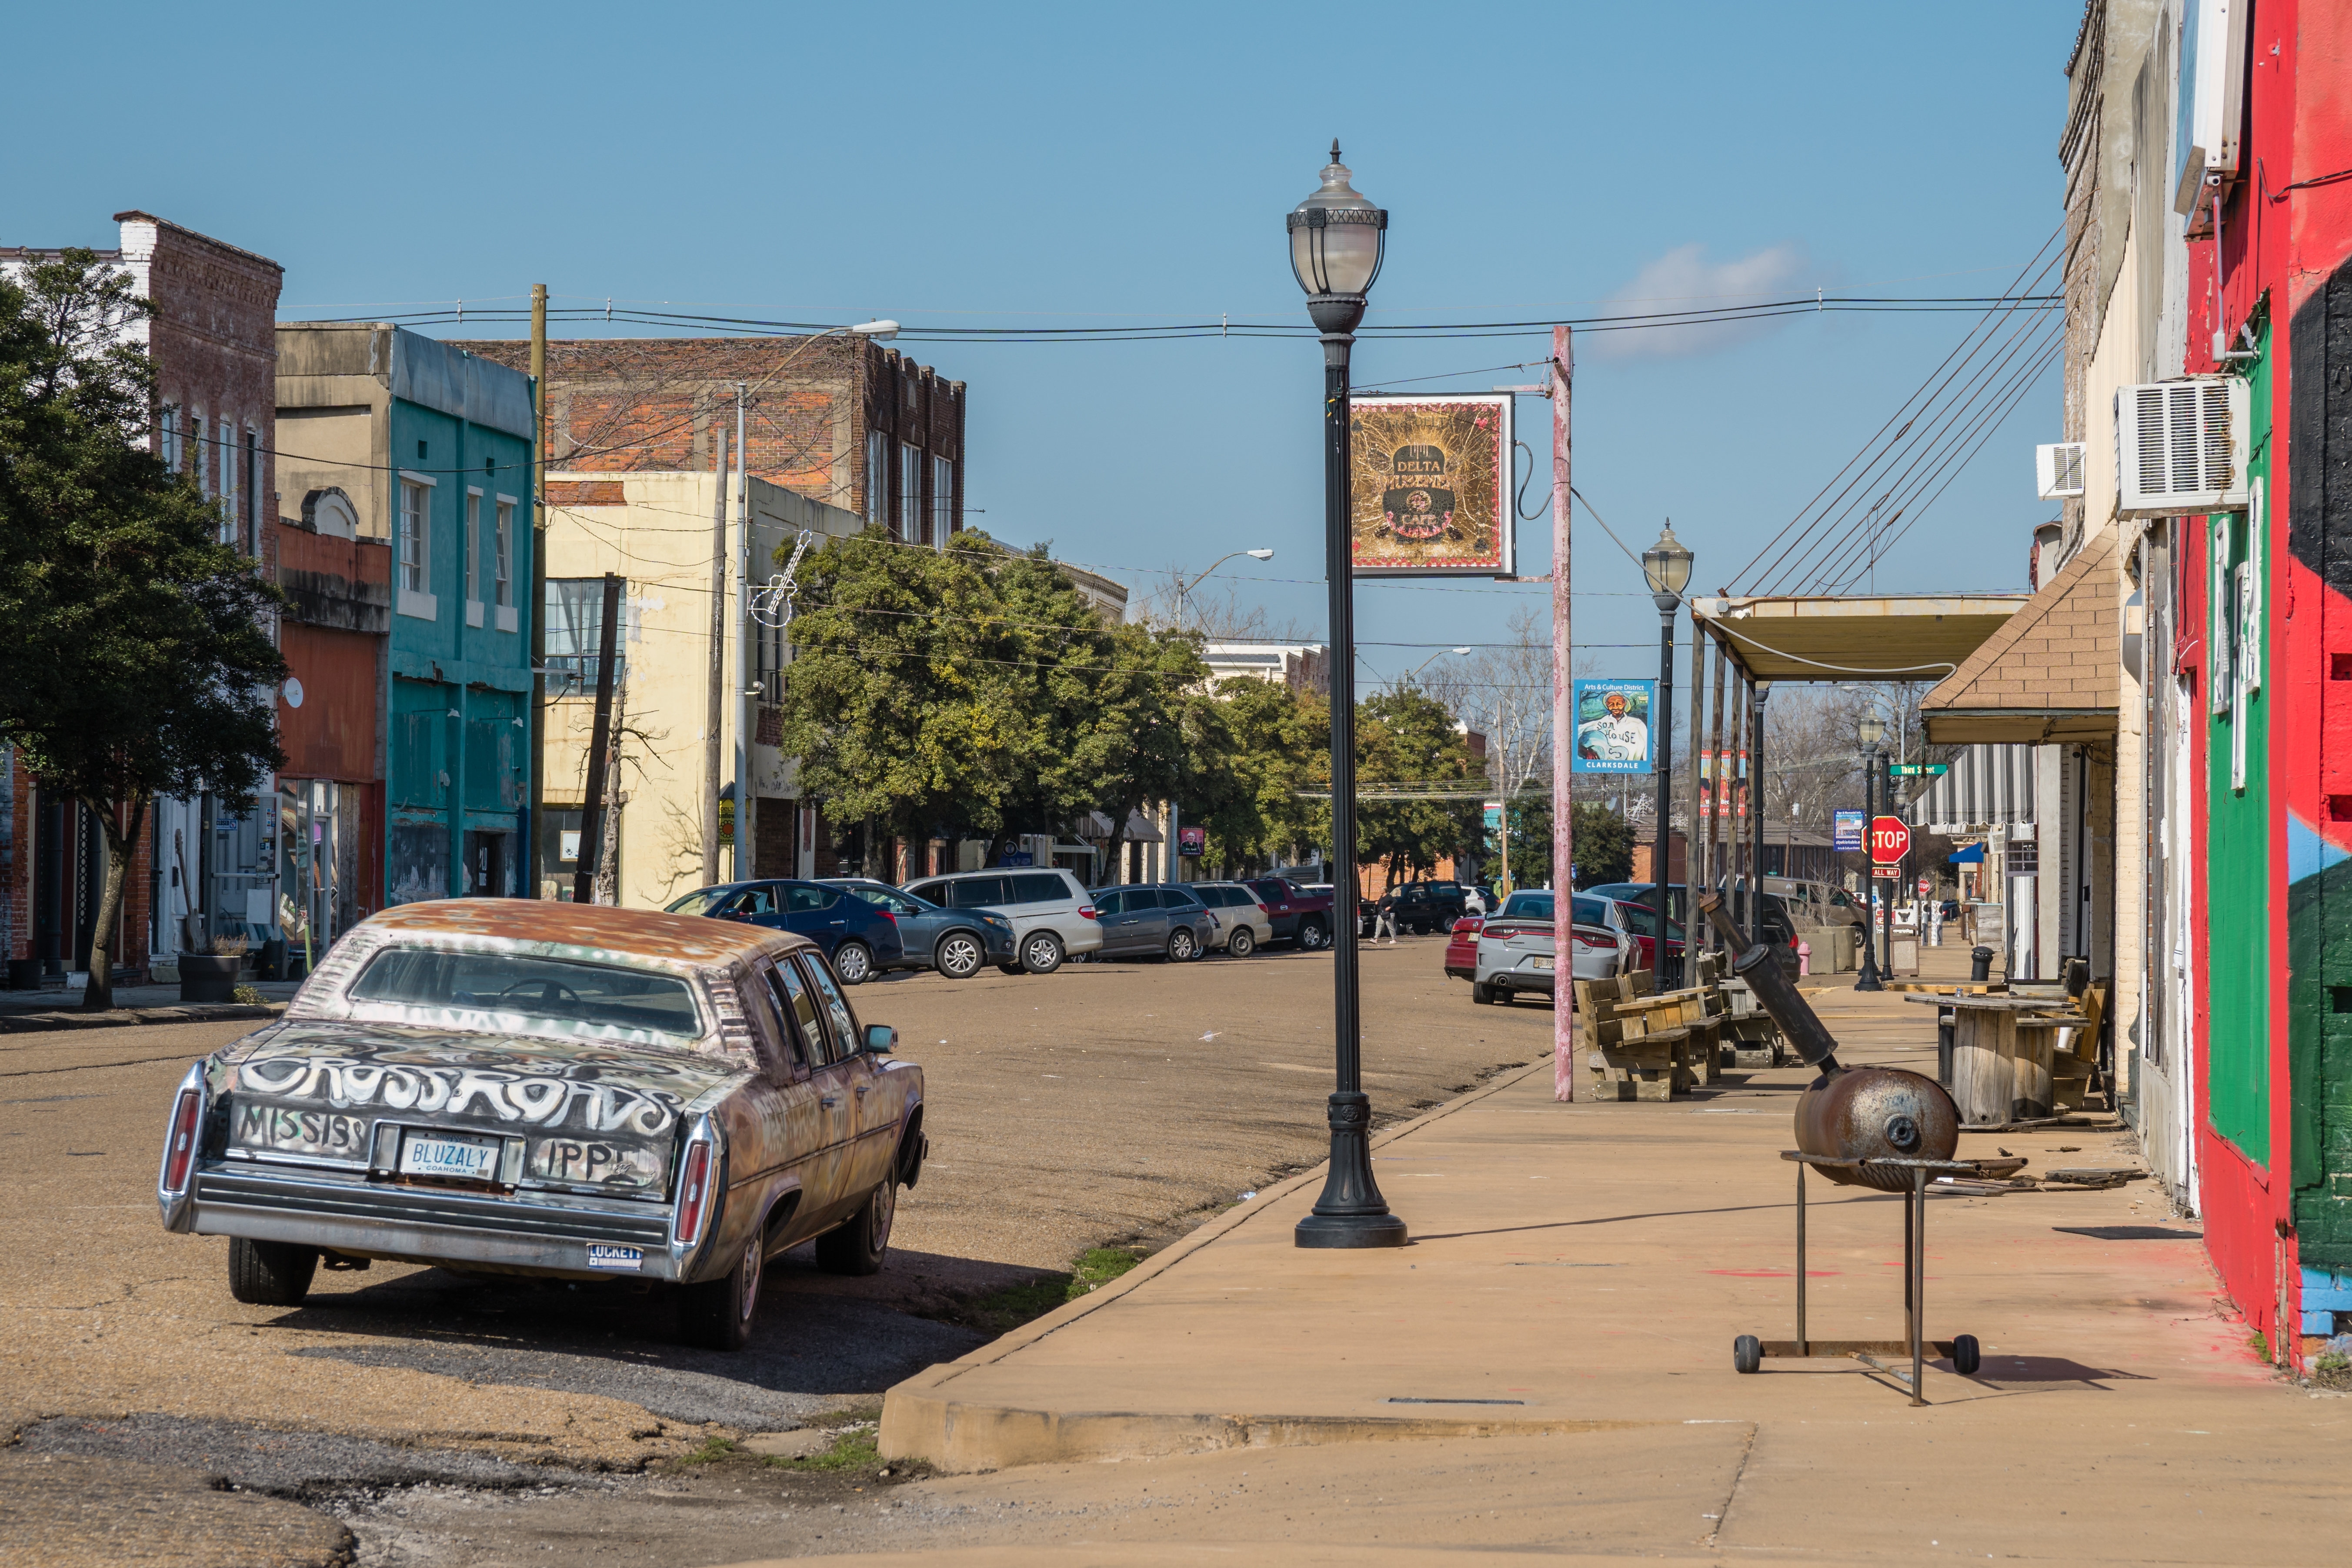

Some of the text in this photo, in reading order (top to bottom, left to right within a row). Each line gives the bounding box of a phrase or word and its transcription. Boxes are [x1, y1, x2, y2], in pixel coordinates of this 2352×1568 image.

[1397, 461, 1440, 472] DELTA
[240, 1057, 684, 1136] CROSSROADS
[435, 1133, 472, 1143] MISSISSIPPI
[412, 1143, 488, 1168] BLUZALY
[426, 1165, 467, 1174] COAHOMA
[590, 1244, 641, 1259] LUCKETT
